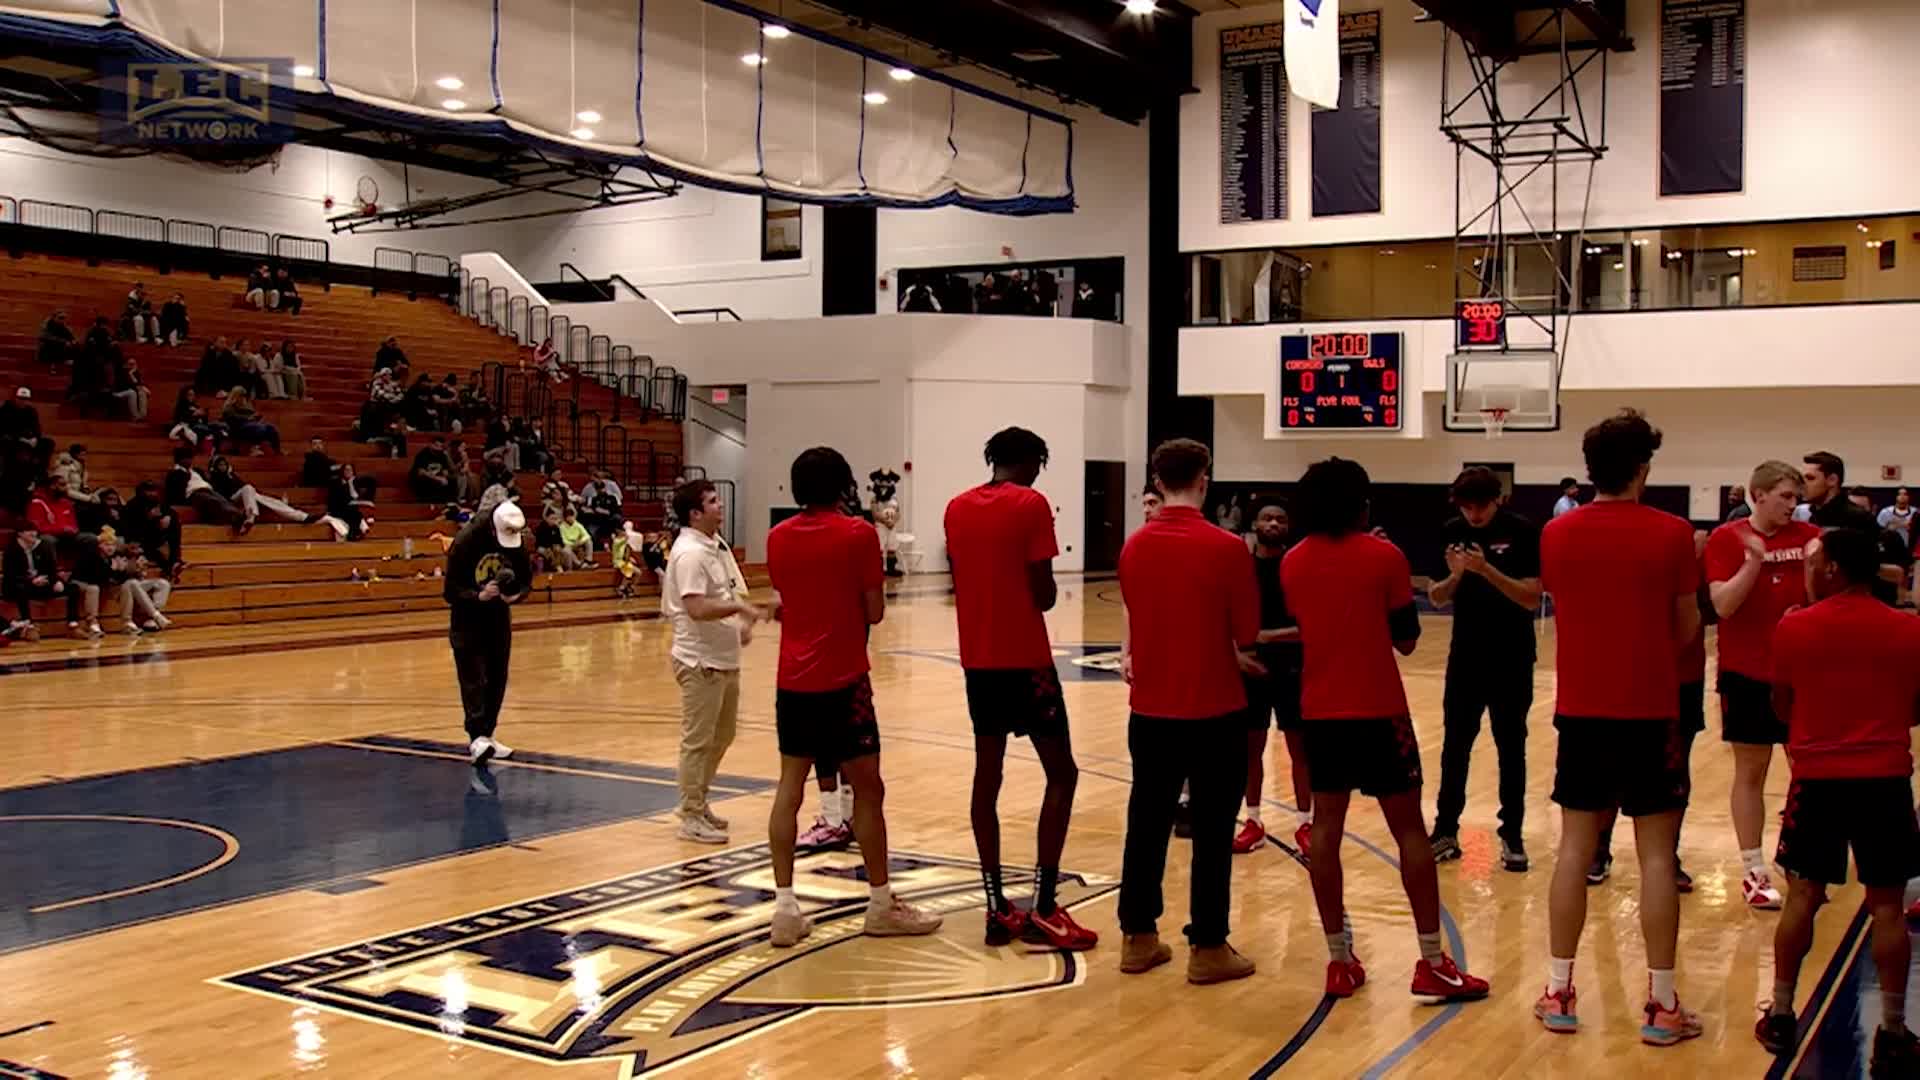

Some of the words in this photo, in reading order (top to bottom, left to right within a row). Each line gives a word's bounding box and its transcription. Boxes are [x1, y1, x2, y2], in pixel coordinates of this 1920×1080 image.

[1463, 303, 1501, 319] 20:00
[1469, 319, 1496, 341] 30
[1312, 335, 1368, 356] 20:00
[1301, 371, 1314, 392] 0
[1382, 370, 1396, 391] 0
[1288, 409, 1299, 425] 0
[1385, 408, 1396, 424] 0
[260, 934, 433, 982] LITTLE
[448, 902, 560, 934] EAST
[621, 999, 688, 1032] PLAY
[666, 954, 769, 999] ANYONE
